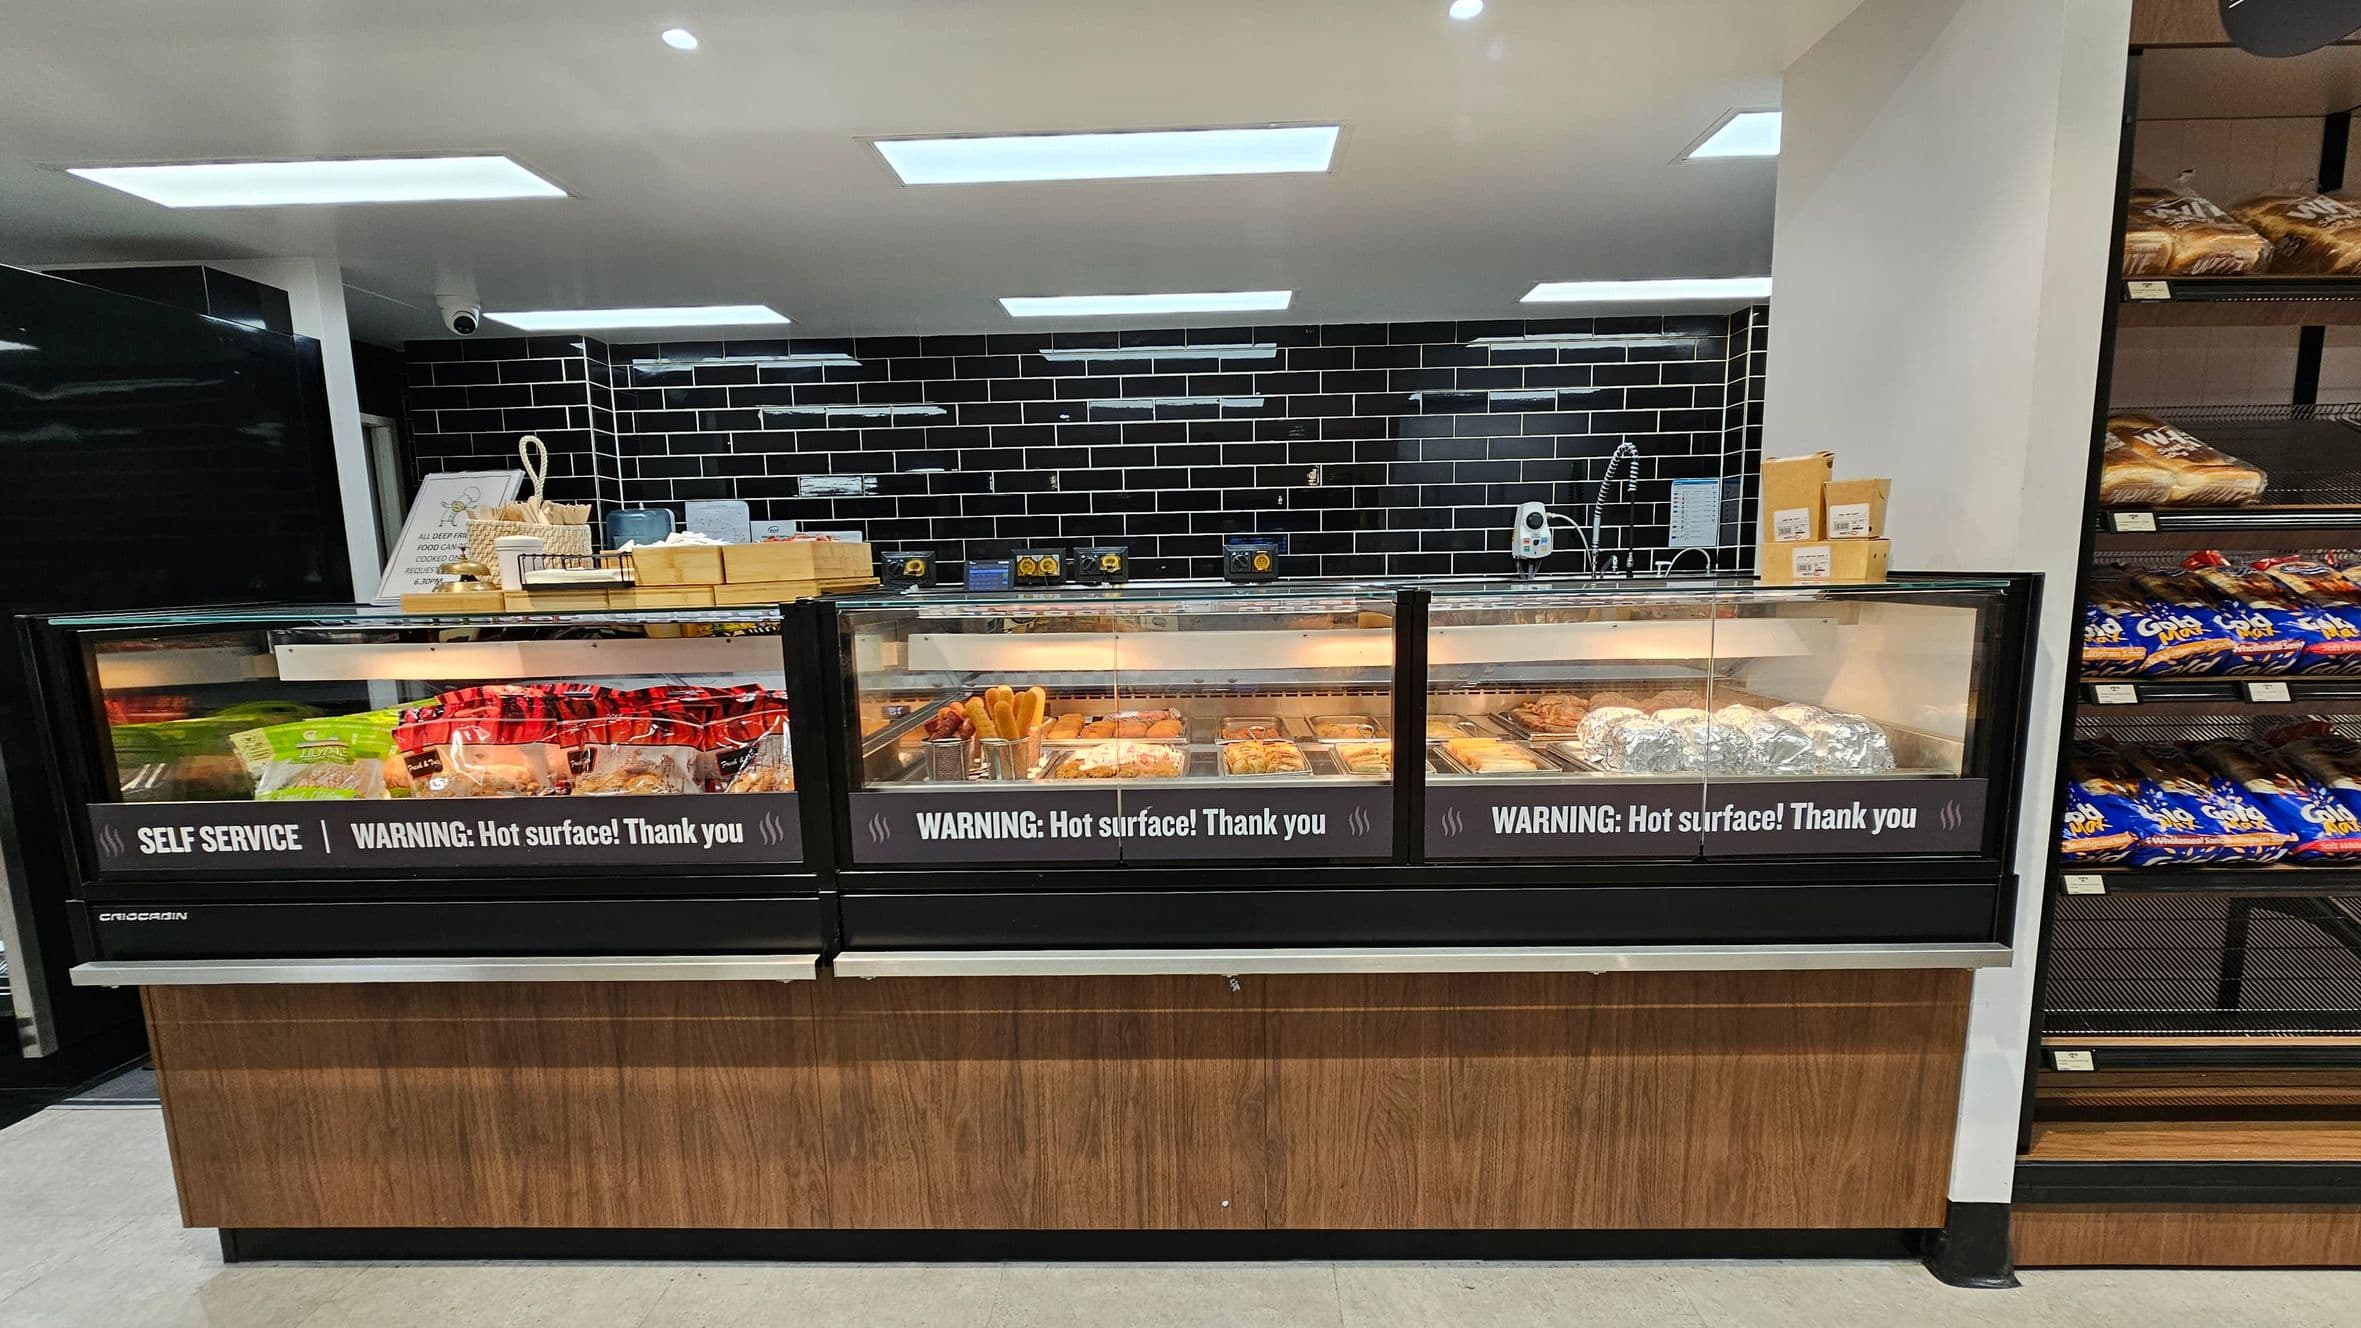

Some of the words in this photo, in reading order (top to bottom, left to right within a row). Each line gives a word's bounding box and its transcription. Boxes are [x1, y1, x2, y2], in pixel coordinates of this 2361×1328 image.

[432, 532, 453, 540] DEEP
[415, 555, 447, 563] COOKED
[2136, 614, 2203, 637] Gold
[2213, 612, 2274, 630] Gold
[916, 810, 1044, 840] WARNING:
[1050, 810, 1093, 838] Hot
[1099, 808, 1197, 838] surface!
[1203, 807, 1277, 836] Thank
[1282, 813, 1326, 841] you
[1491, 805, 1622, 834] WARNING:
[1627, 804, 1673, 833] Hot
[1678, 802, 1784, 833] surface!
[1789, 801, 1866, 831] Thank
[1871, 807, 1918, 834] you
[2200, 804, 2268, 823] Gold
[2301, 804, 2357, 824] Gold
[137, 827, 195, 854] SELF
[199, 824, 302, 852] SERVICE
[350, 820, 475, 849] WARNING:
[478, 819, 521, 847] Hot
[525, 818, 620, 846] surface!
[622, 817, 698, 845] Thank
[702, 822, 744, 849] you
